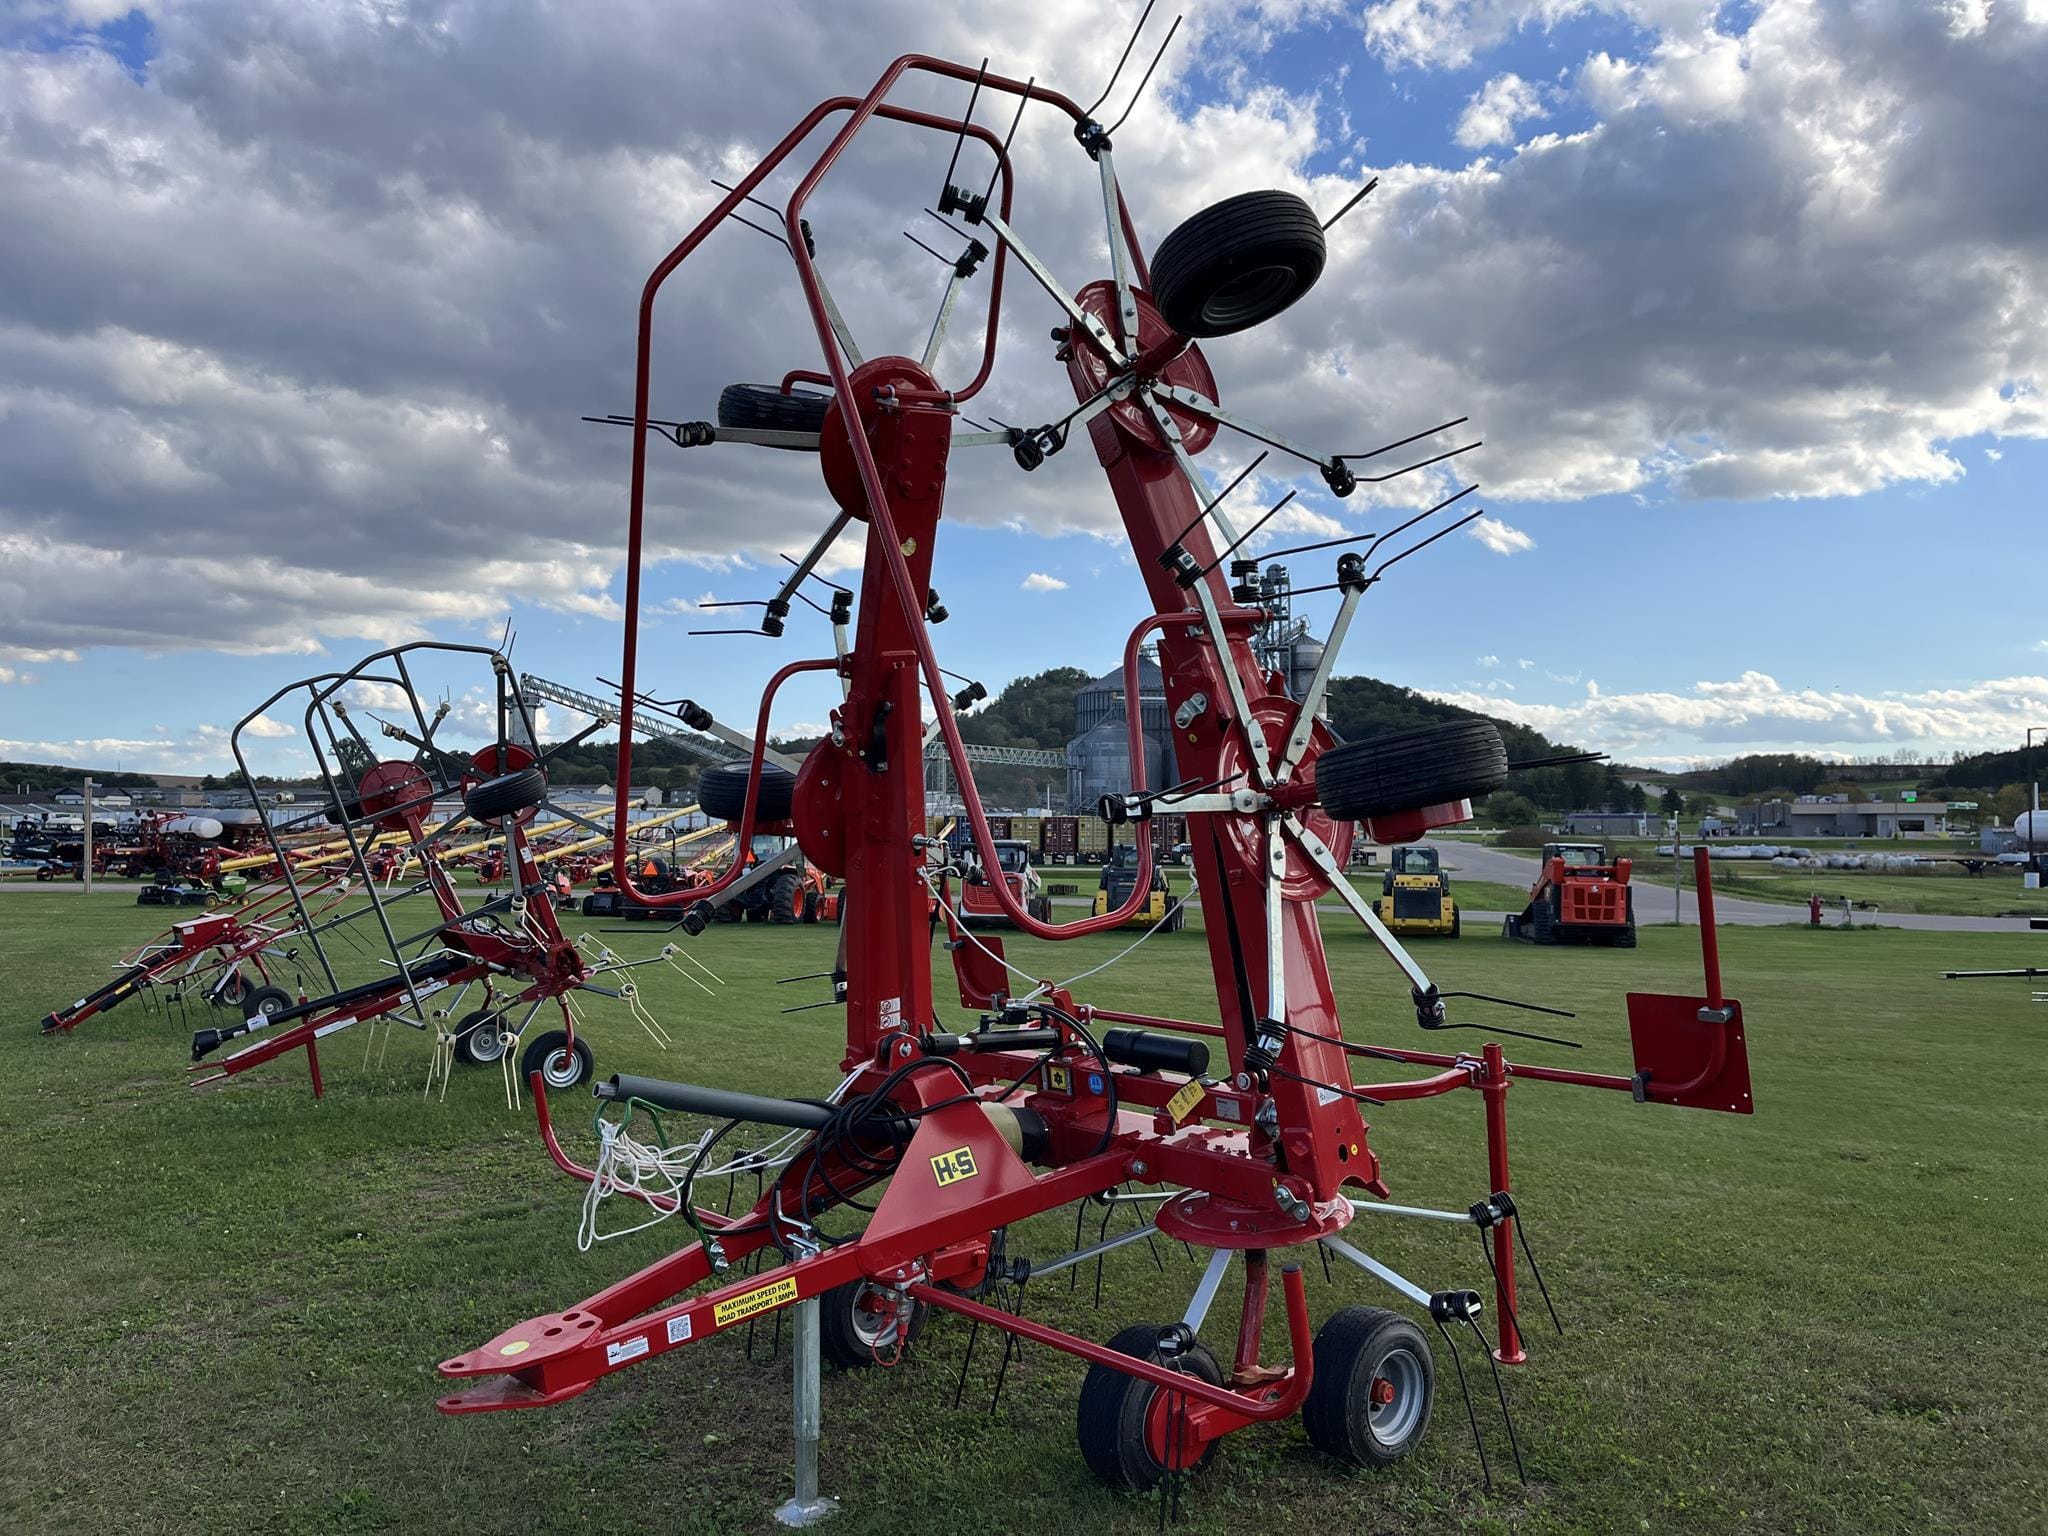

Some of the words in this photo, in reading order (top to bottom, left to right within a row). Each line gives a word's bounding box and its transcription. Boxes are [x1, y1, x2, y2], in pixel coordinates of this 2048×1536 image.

[934, 1151, 974, 1182] H&S
[718, 1312, 736, 1324] ROAD
[737, 1298, 773, 1316] TRANSPORT
[721, 1295, 756, 1312] MAXIMUM
[757, 1287, 777, 1299] SPEED
[778, 1282, 790, 1292] FOR
